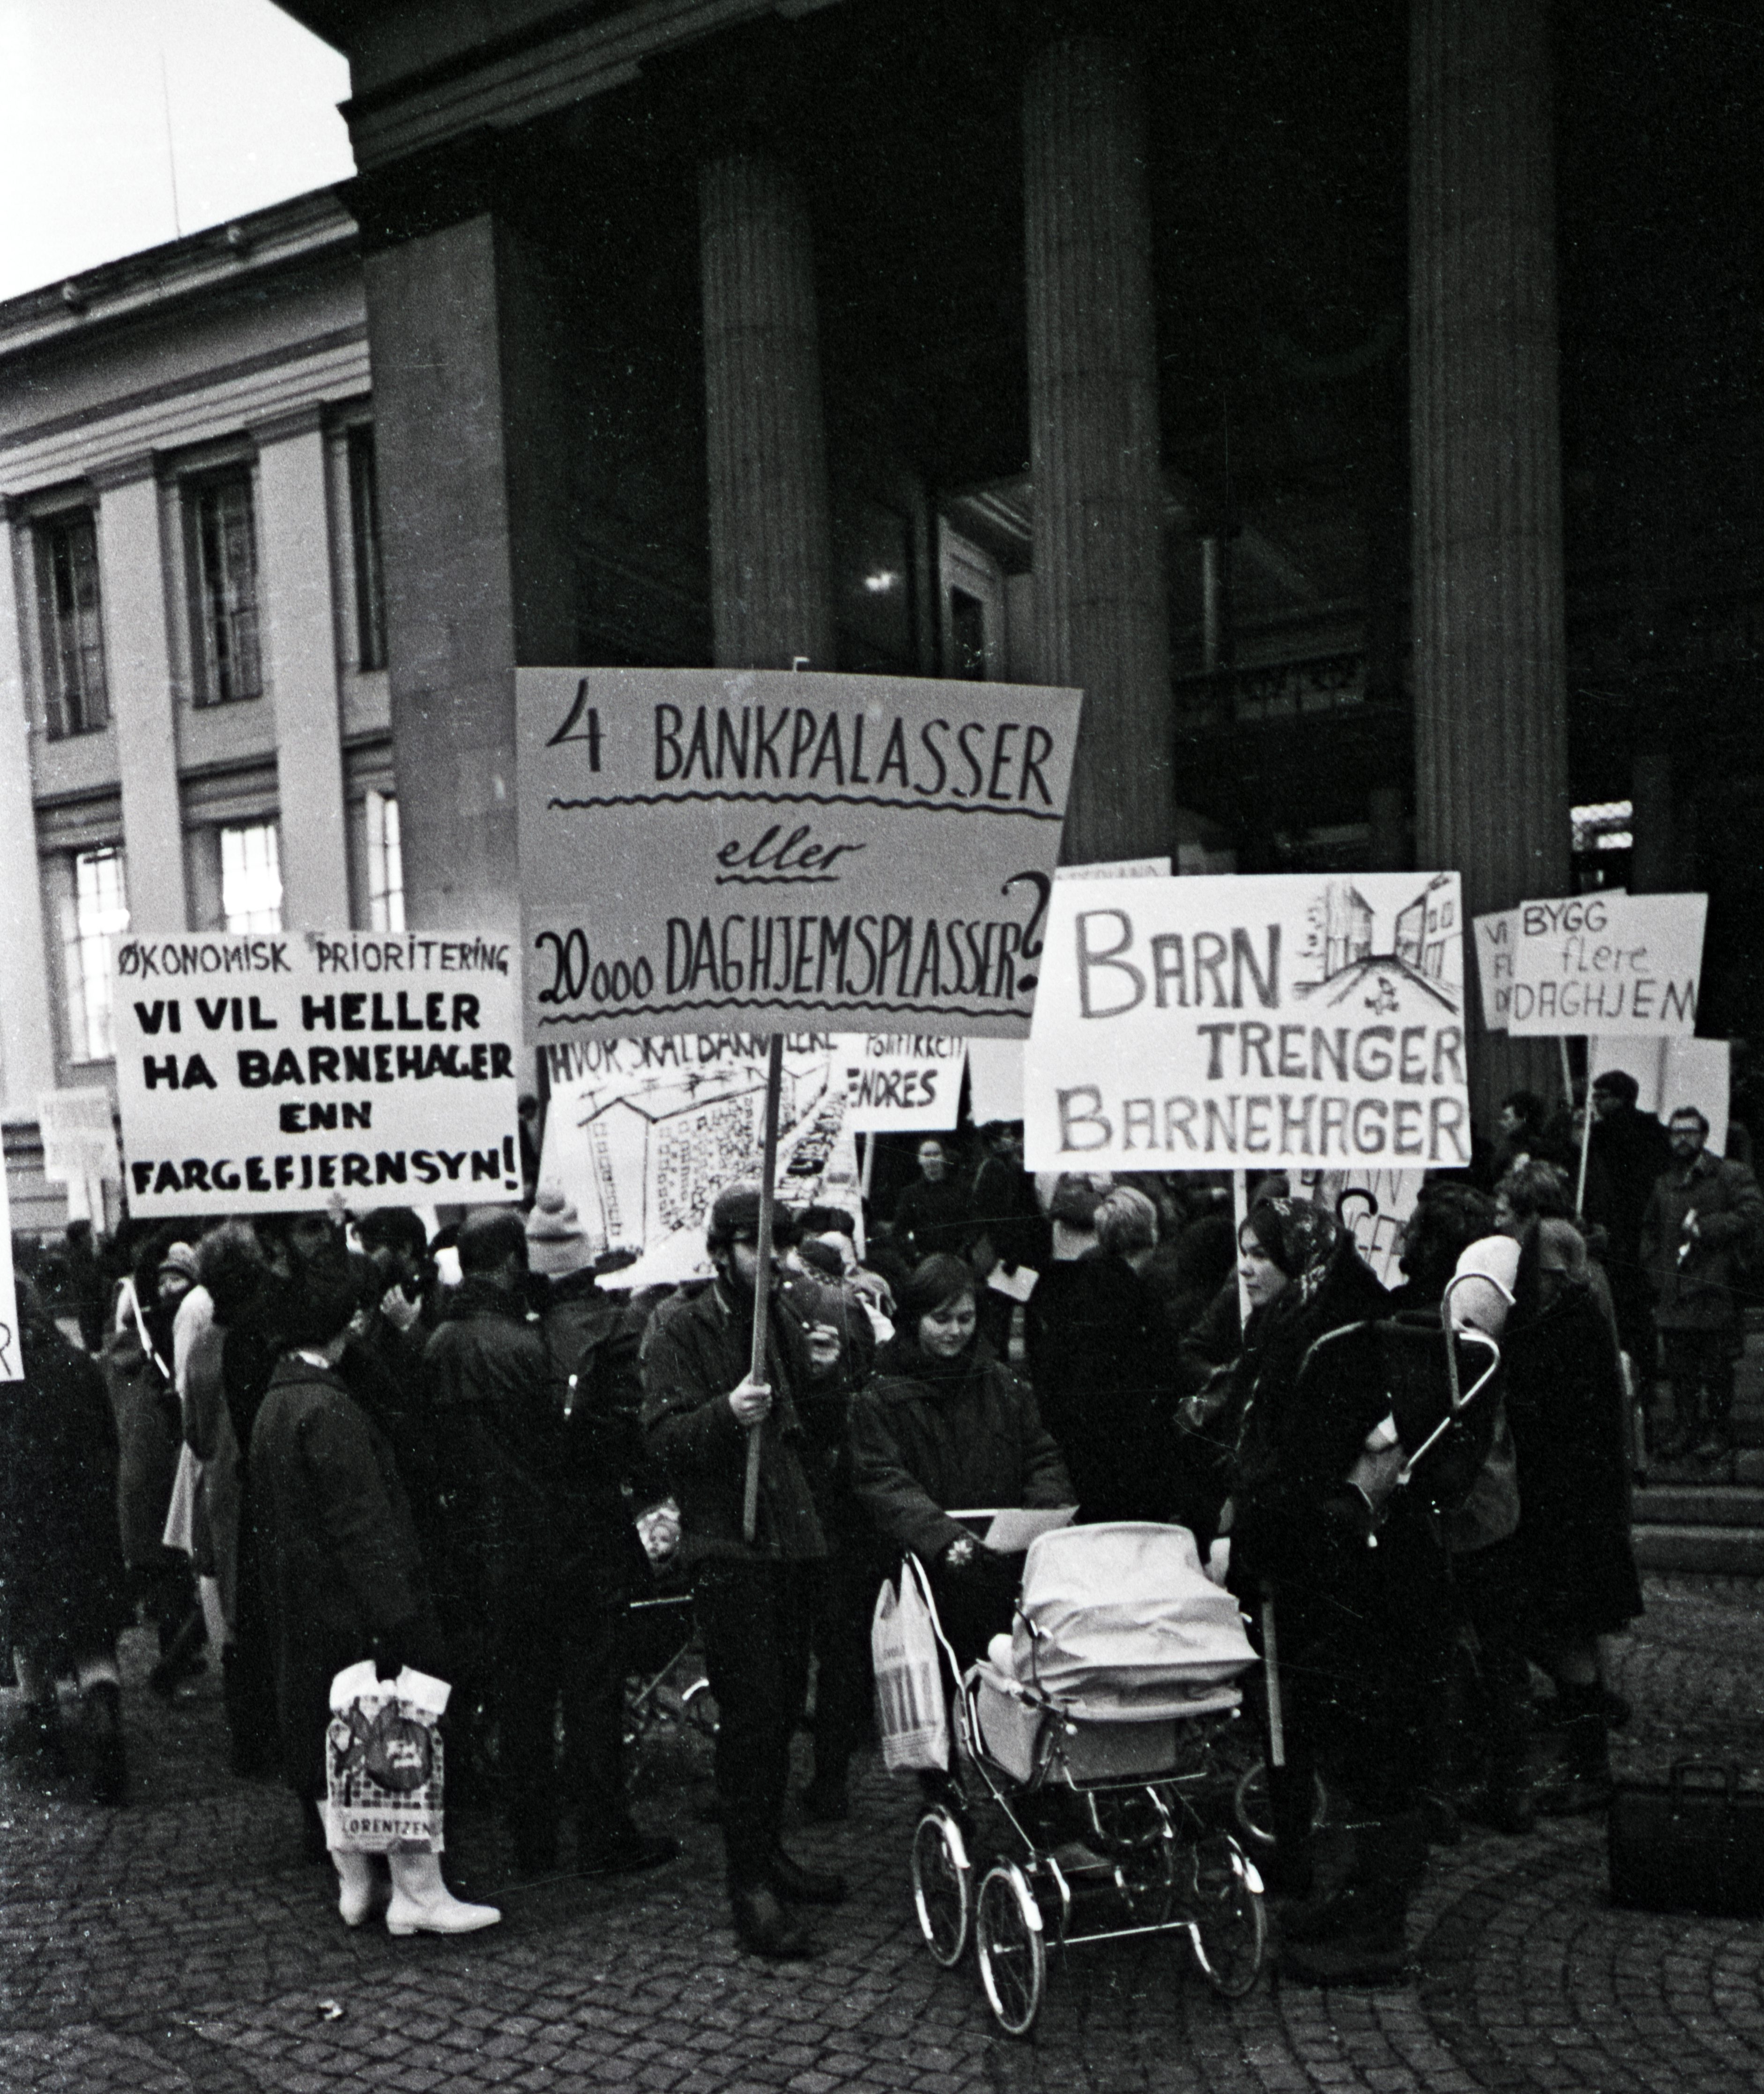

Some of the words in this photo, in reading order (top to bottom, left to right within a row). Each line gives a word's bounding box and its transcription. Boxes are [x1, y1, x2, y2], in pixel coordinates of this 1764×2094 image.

[546, 676, 606, 772] 4
[655, 704, 1054, 805] BANKPALASSER
[716, 825, 868, 870] eller
[1523, 899, 1608, 936] BYGG
[536, 929, 654, 1004] 20000
[1075, 908, 1281, 1018] BARN
[134, 1000, 181, 1034] VI
[195, 996, 277, 1031] VIL
[301, 992, 480, 1031] HELLER
[1514, 977, 1696, 1023] DAGHJEM
[143, 1054, 217, 1090] HA
[238, 1043, 515, 1088] BARNEHAGER
[1197, 1021, 1464, 1085] TRENGER
[847, 1068, 938, 1108] ENDRES
[280, 1101, 372, 1133] ENN
[1055, 1084, 1471, 1162] BARNEHAGER
[131, 1136, 518, 1195] FARGEFJERNSYN!
